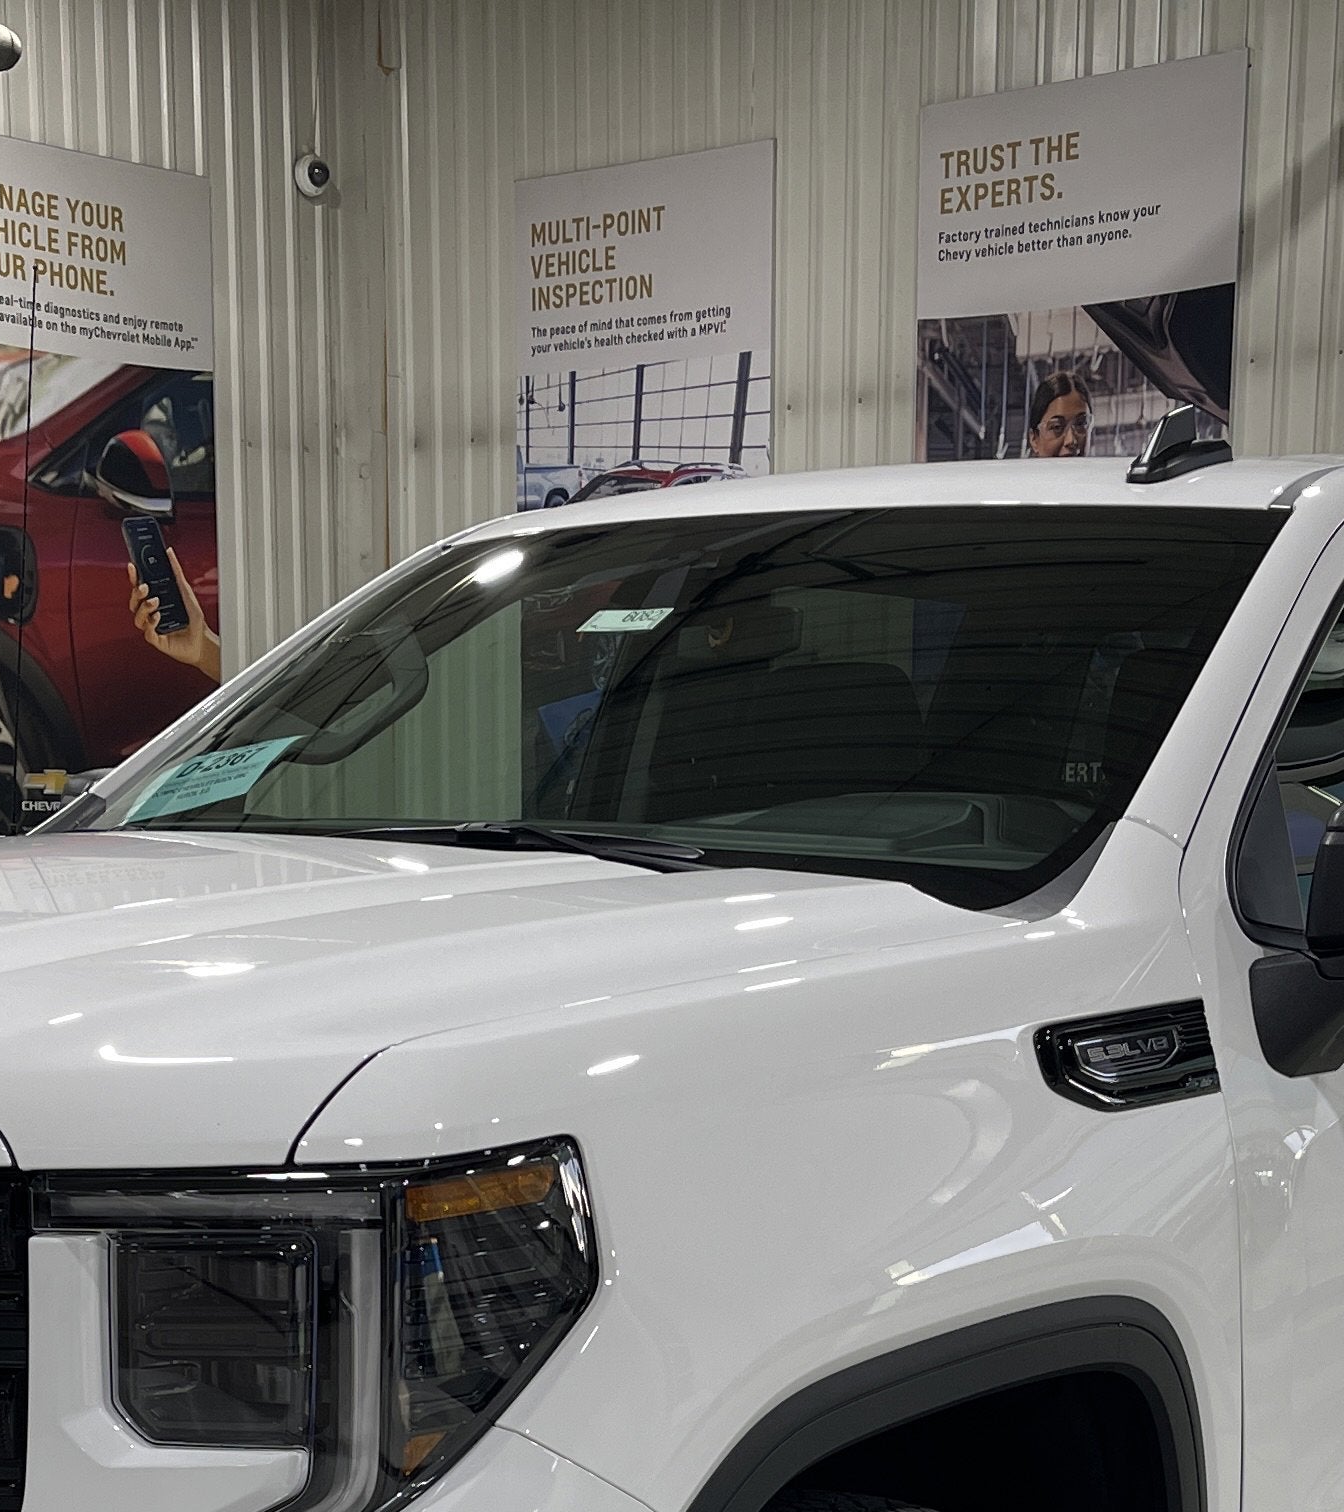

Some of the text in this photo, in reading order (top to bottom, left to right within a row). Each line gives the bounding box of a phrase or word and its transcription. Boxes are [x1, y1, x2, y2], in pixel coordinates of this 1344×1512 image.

[940, 131, 1080, 179] TRUST THE
[940, 172, 1063, 215] EXPERTS.
[65, 197, 124, 233] YOUR
[530, 205, 666, 248] MULTI-POINT
[938, 203, 1161, 245] Factory trained technicians know your
[67, 231, 126, 266] FROM
[530, 245, 616, 279] VEHICLE
[938, 228, 1132, 263] Chevy vehicle better than anyone.
[32, 258, 115, 297] PHONE.
[531, 273, 653, 312] INSPECTION
[44, 301, 100, 322] diagnostics
[103, 313, 120, 325] and
[123, 315, 147, 331] enjoy
[150, 320, 183, 332] remote
[46, 319, 58, 331] on
[61, 321, 76, 335] the
[79, 326, 140, 343] myChevrolet
[142, 332, 172, 348] Mobile
[531, 305, 731, 339] The peace of mind that comes from getting
[530, 342, 552, 357] your
[553, 336, 592, 353] vehicle's
[594, 333, 623, 348] health
[625, 328, 664, 345] checked
[667, 326, 688, 340] with
[690, 327, 696, 337] a
[21, 800, 61, 811] CHEVR
